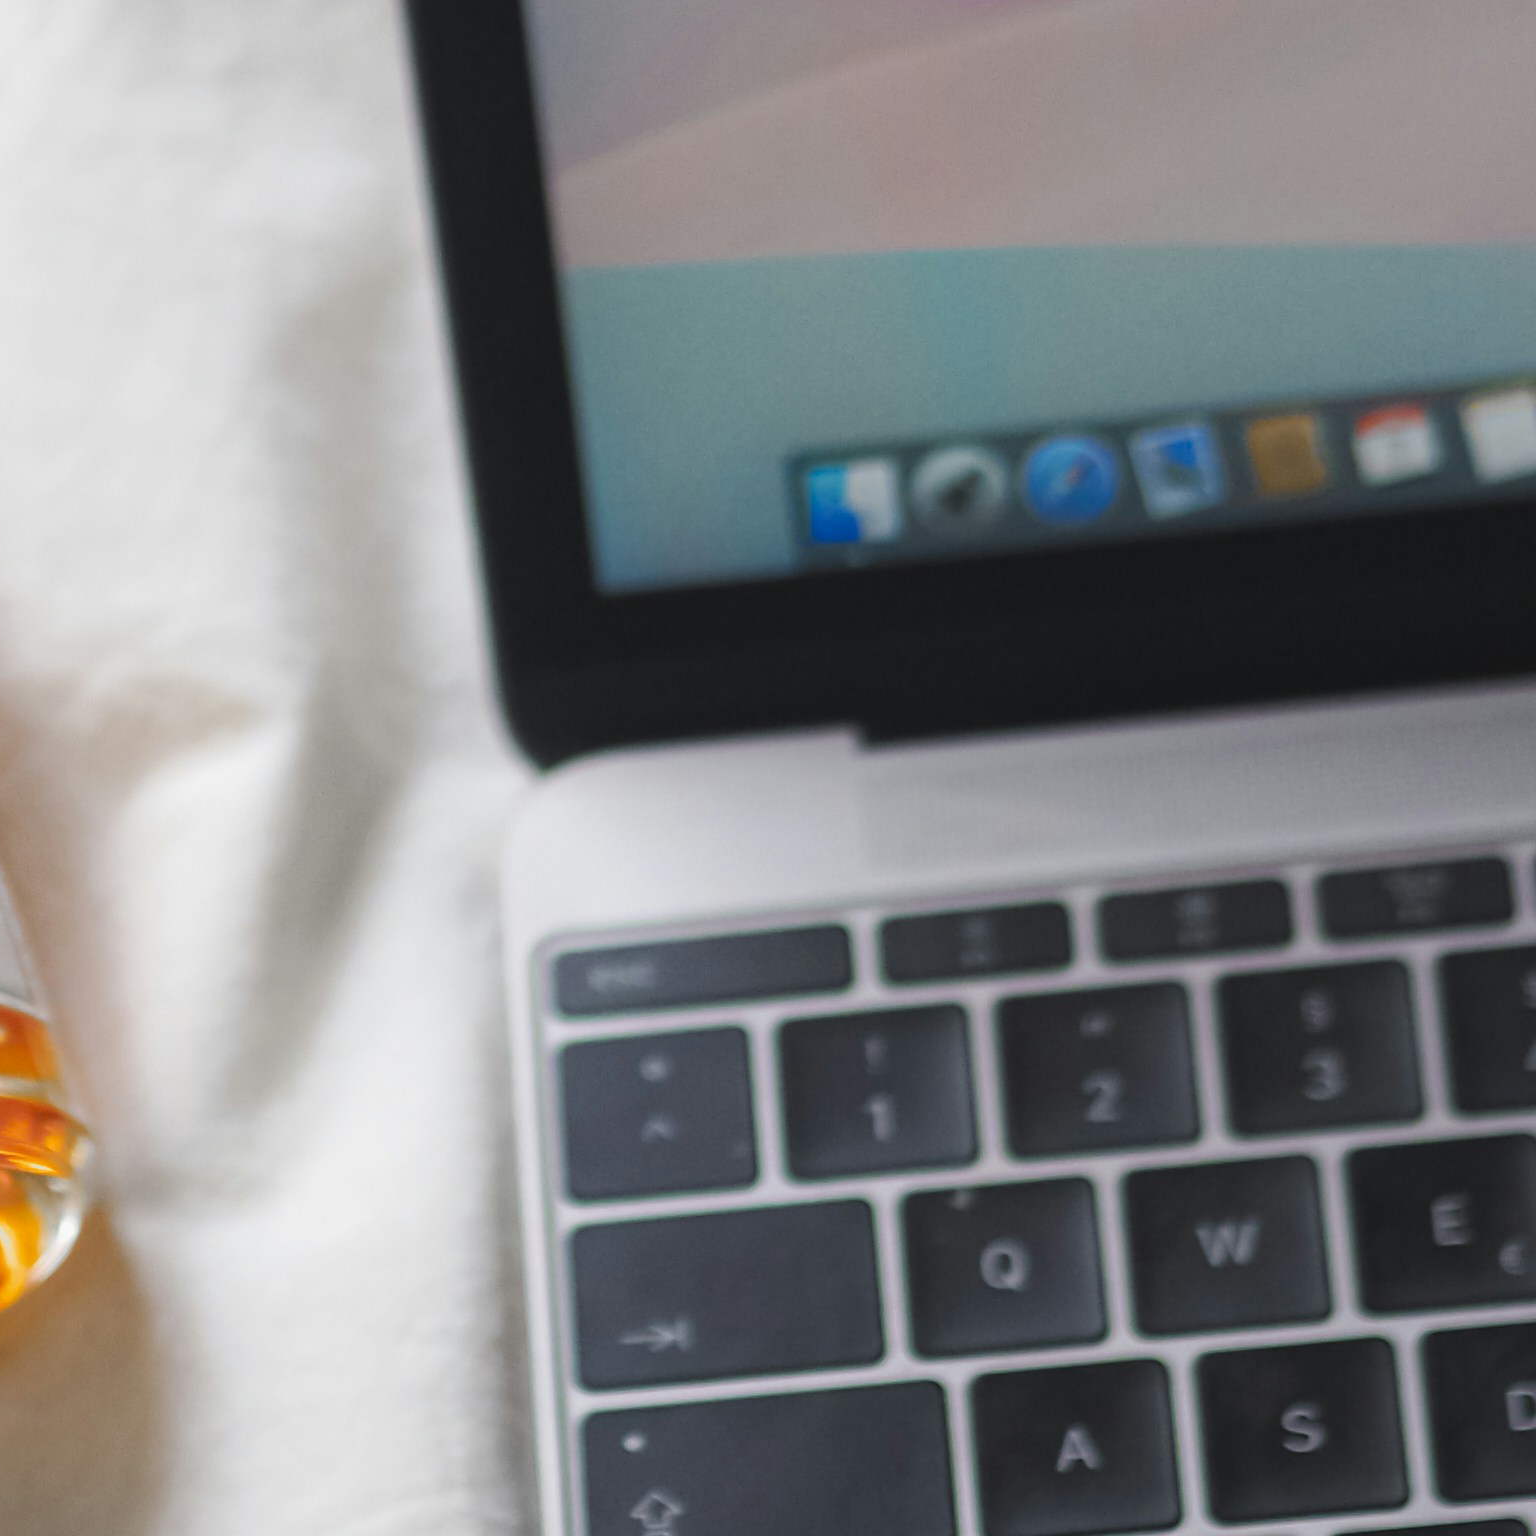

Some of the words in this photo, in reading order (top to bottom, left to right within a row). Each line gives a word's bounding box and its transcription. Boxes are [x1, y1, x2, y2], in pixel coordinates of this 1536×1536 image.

[1080, 1069, 1124, 1124] 2
[1301, 1046, 1349, 1102] 3
[866, 1091, 897, 1143] 1
[1196, 1219, 1262, 1269] W
[1429, 1192, 1473, 1247] E
[980, 1237, 1033, 1292] Q
[1279, 1402, 1327, 1454] S
[1504, 1382, 1536, 1432] D
[1056, 1424, 1103, 1473] A
